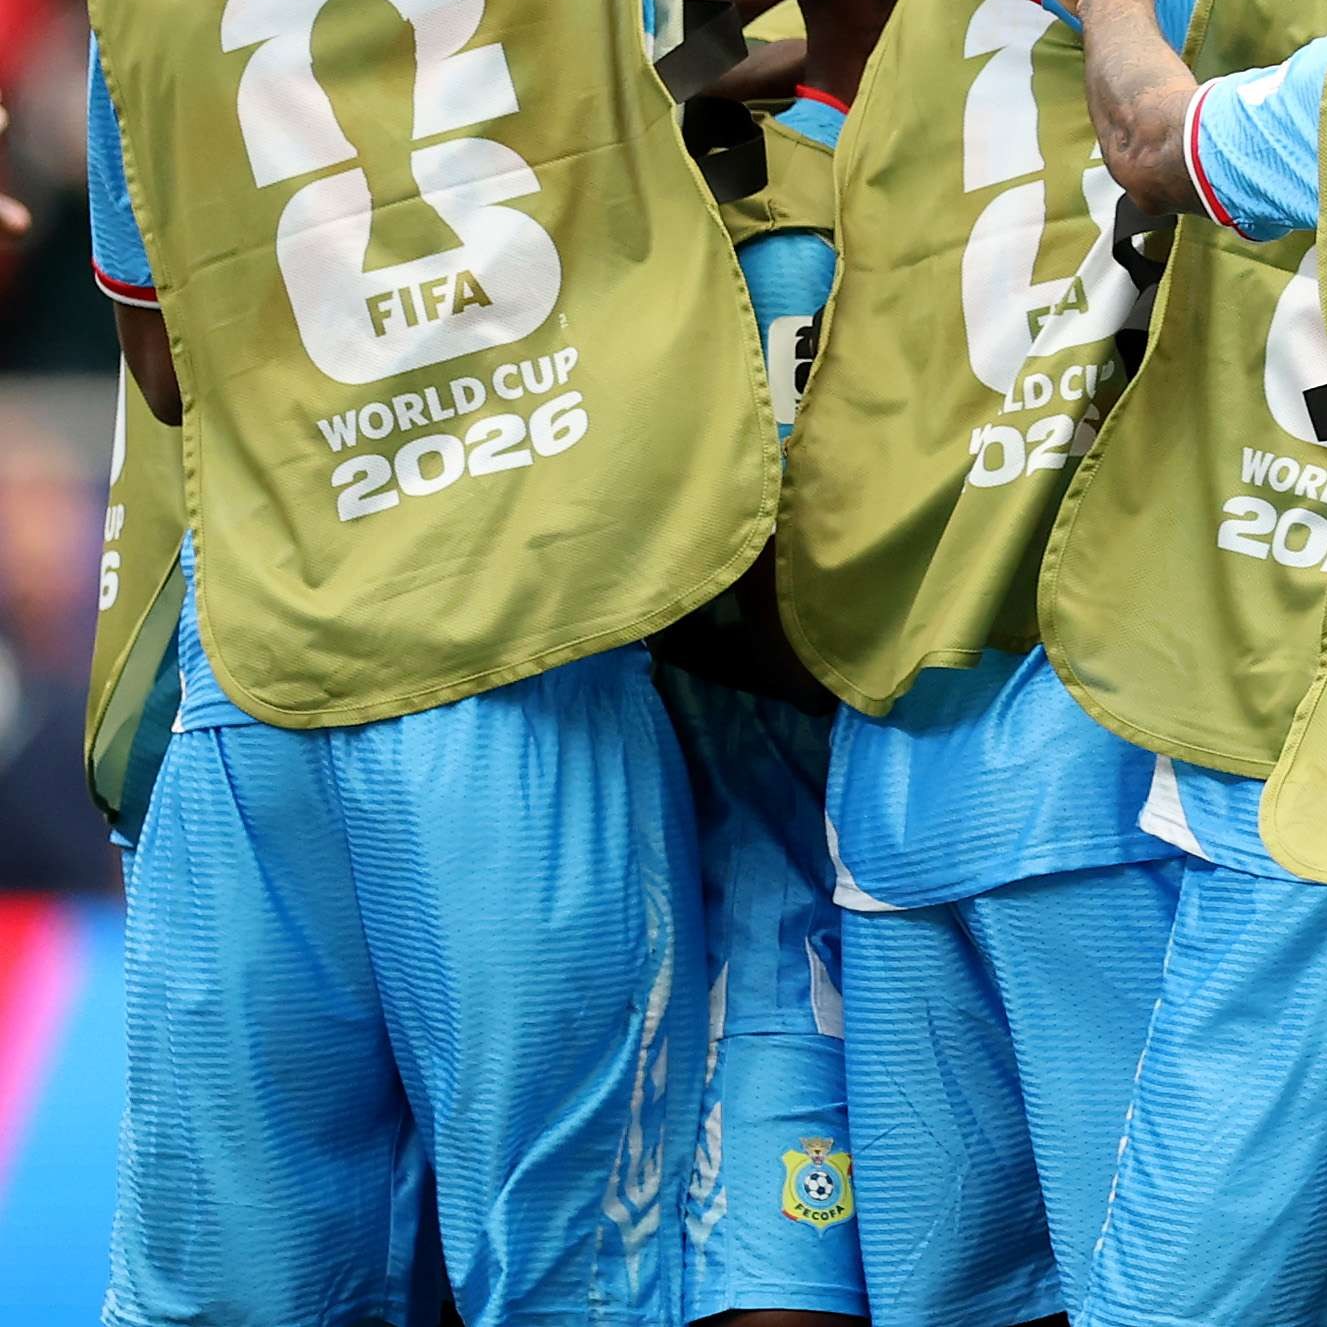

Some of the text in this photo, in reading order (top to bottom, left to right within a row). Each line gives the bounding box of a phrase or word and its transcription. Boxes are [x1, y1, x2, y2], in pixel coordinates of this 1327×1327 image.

[365, 269, 493, 337] FIFA
[316, 346, 579, 453] WORLD CUP
[331, 390, 589, 522] 2026
[794, 1203, 845, 1221] FECOFA
